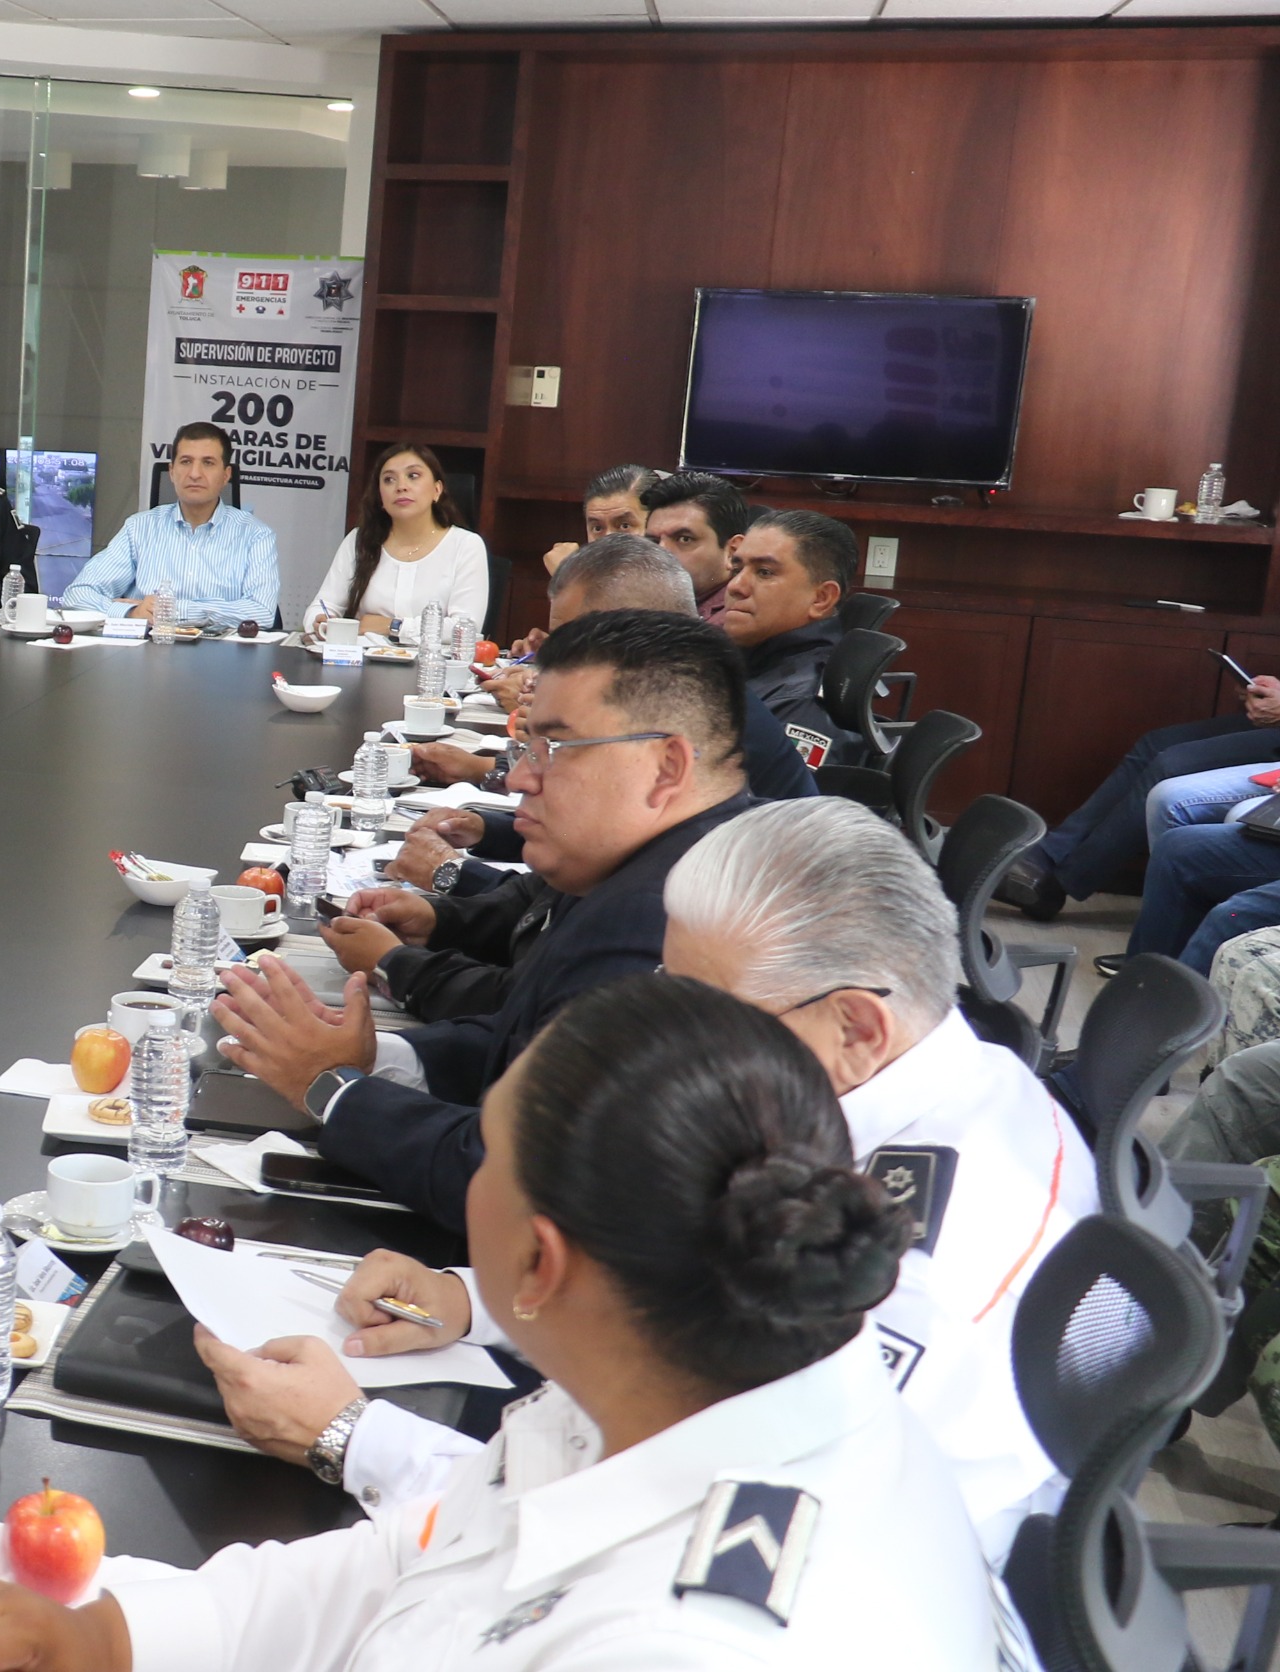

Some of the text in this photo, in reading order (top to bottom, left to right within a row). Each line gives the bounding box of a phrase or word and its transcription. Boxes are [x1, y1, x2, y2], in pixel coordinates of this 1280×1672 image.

[241, 274, 284, 288] 911
[179, 342, 336, 366] SUPERVISIÓN DE PROYECTO
[193, 373, 317, 391] INSTALACIÓN DE
[211, 391, 294, 427] 200
[227, 429, 327, 451] ARAS DE
[790, 728, 827, 747] MEXICO
